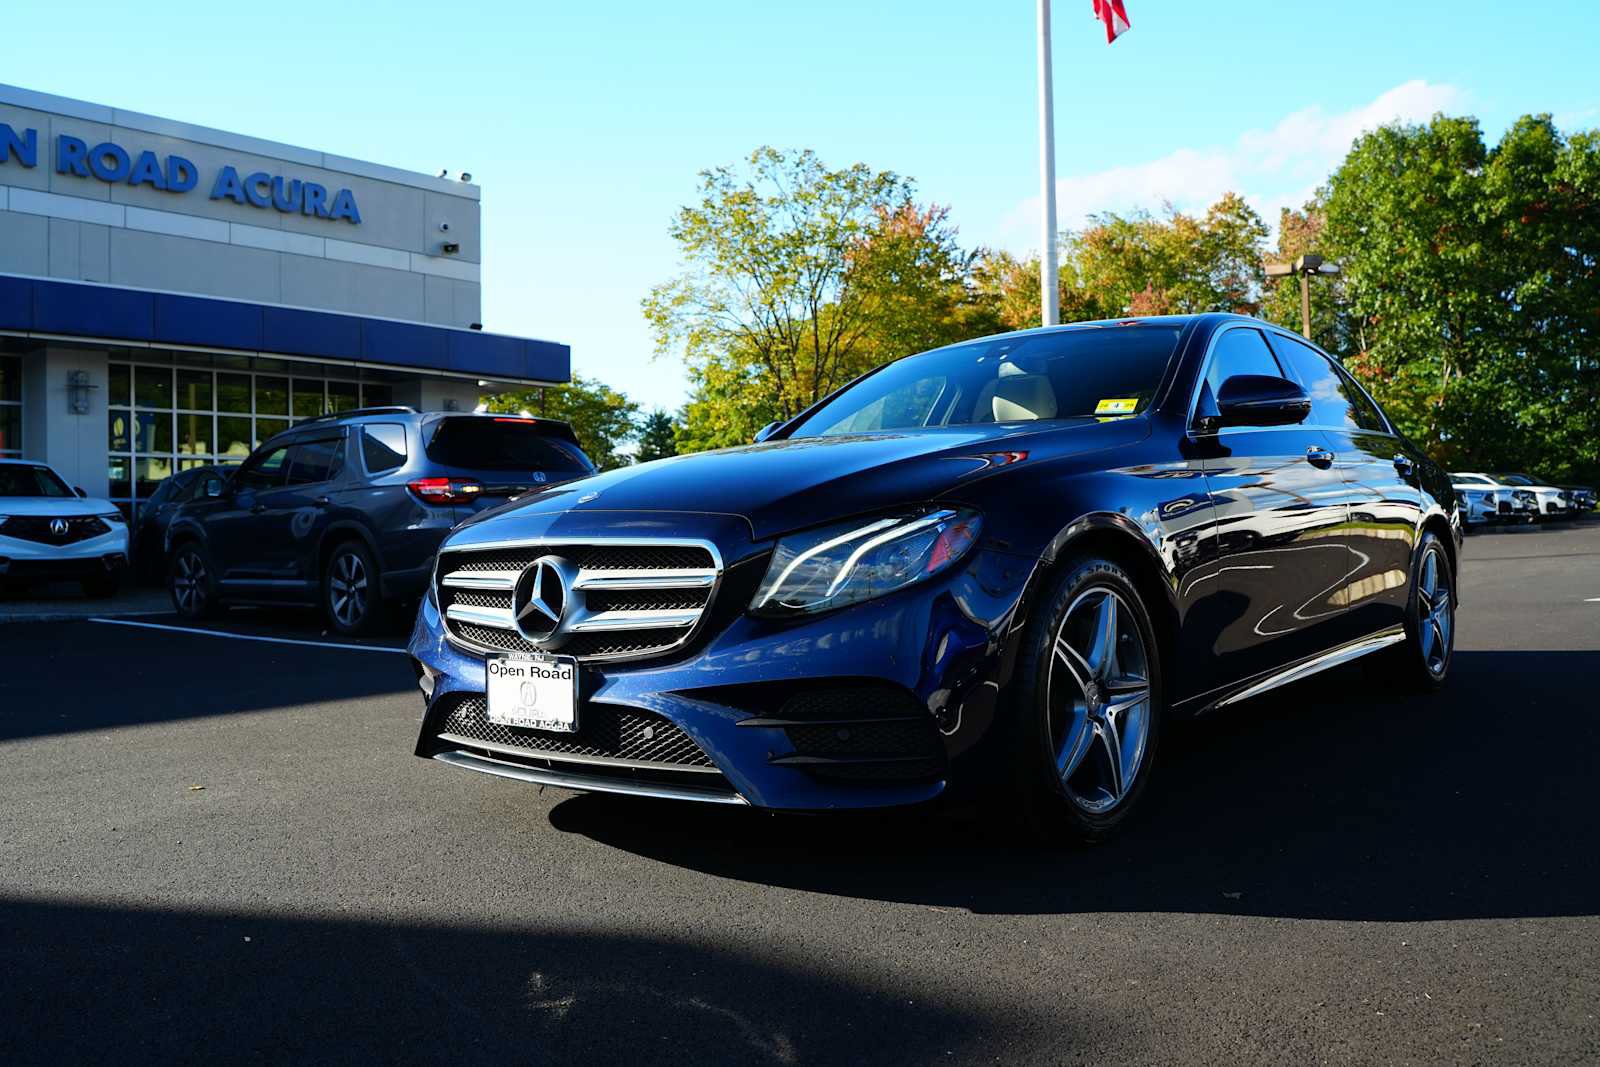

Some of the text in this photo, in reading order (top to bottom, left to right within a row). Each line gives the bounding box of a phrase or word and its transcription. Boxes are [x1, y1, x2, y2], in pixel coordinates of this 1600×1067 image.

[56, 134, 198, 192] ROAD
[209, 165, 361, 224] ACURA
[489, 663, 572, 680] Open Road
[513, 718, 537, 728] ROAD
